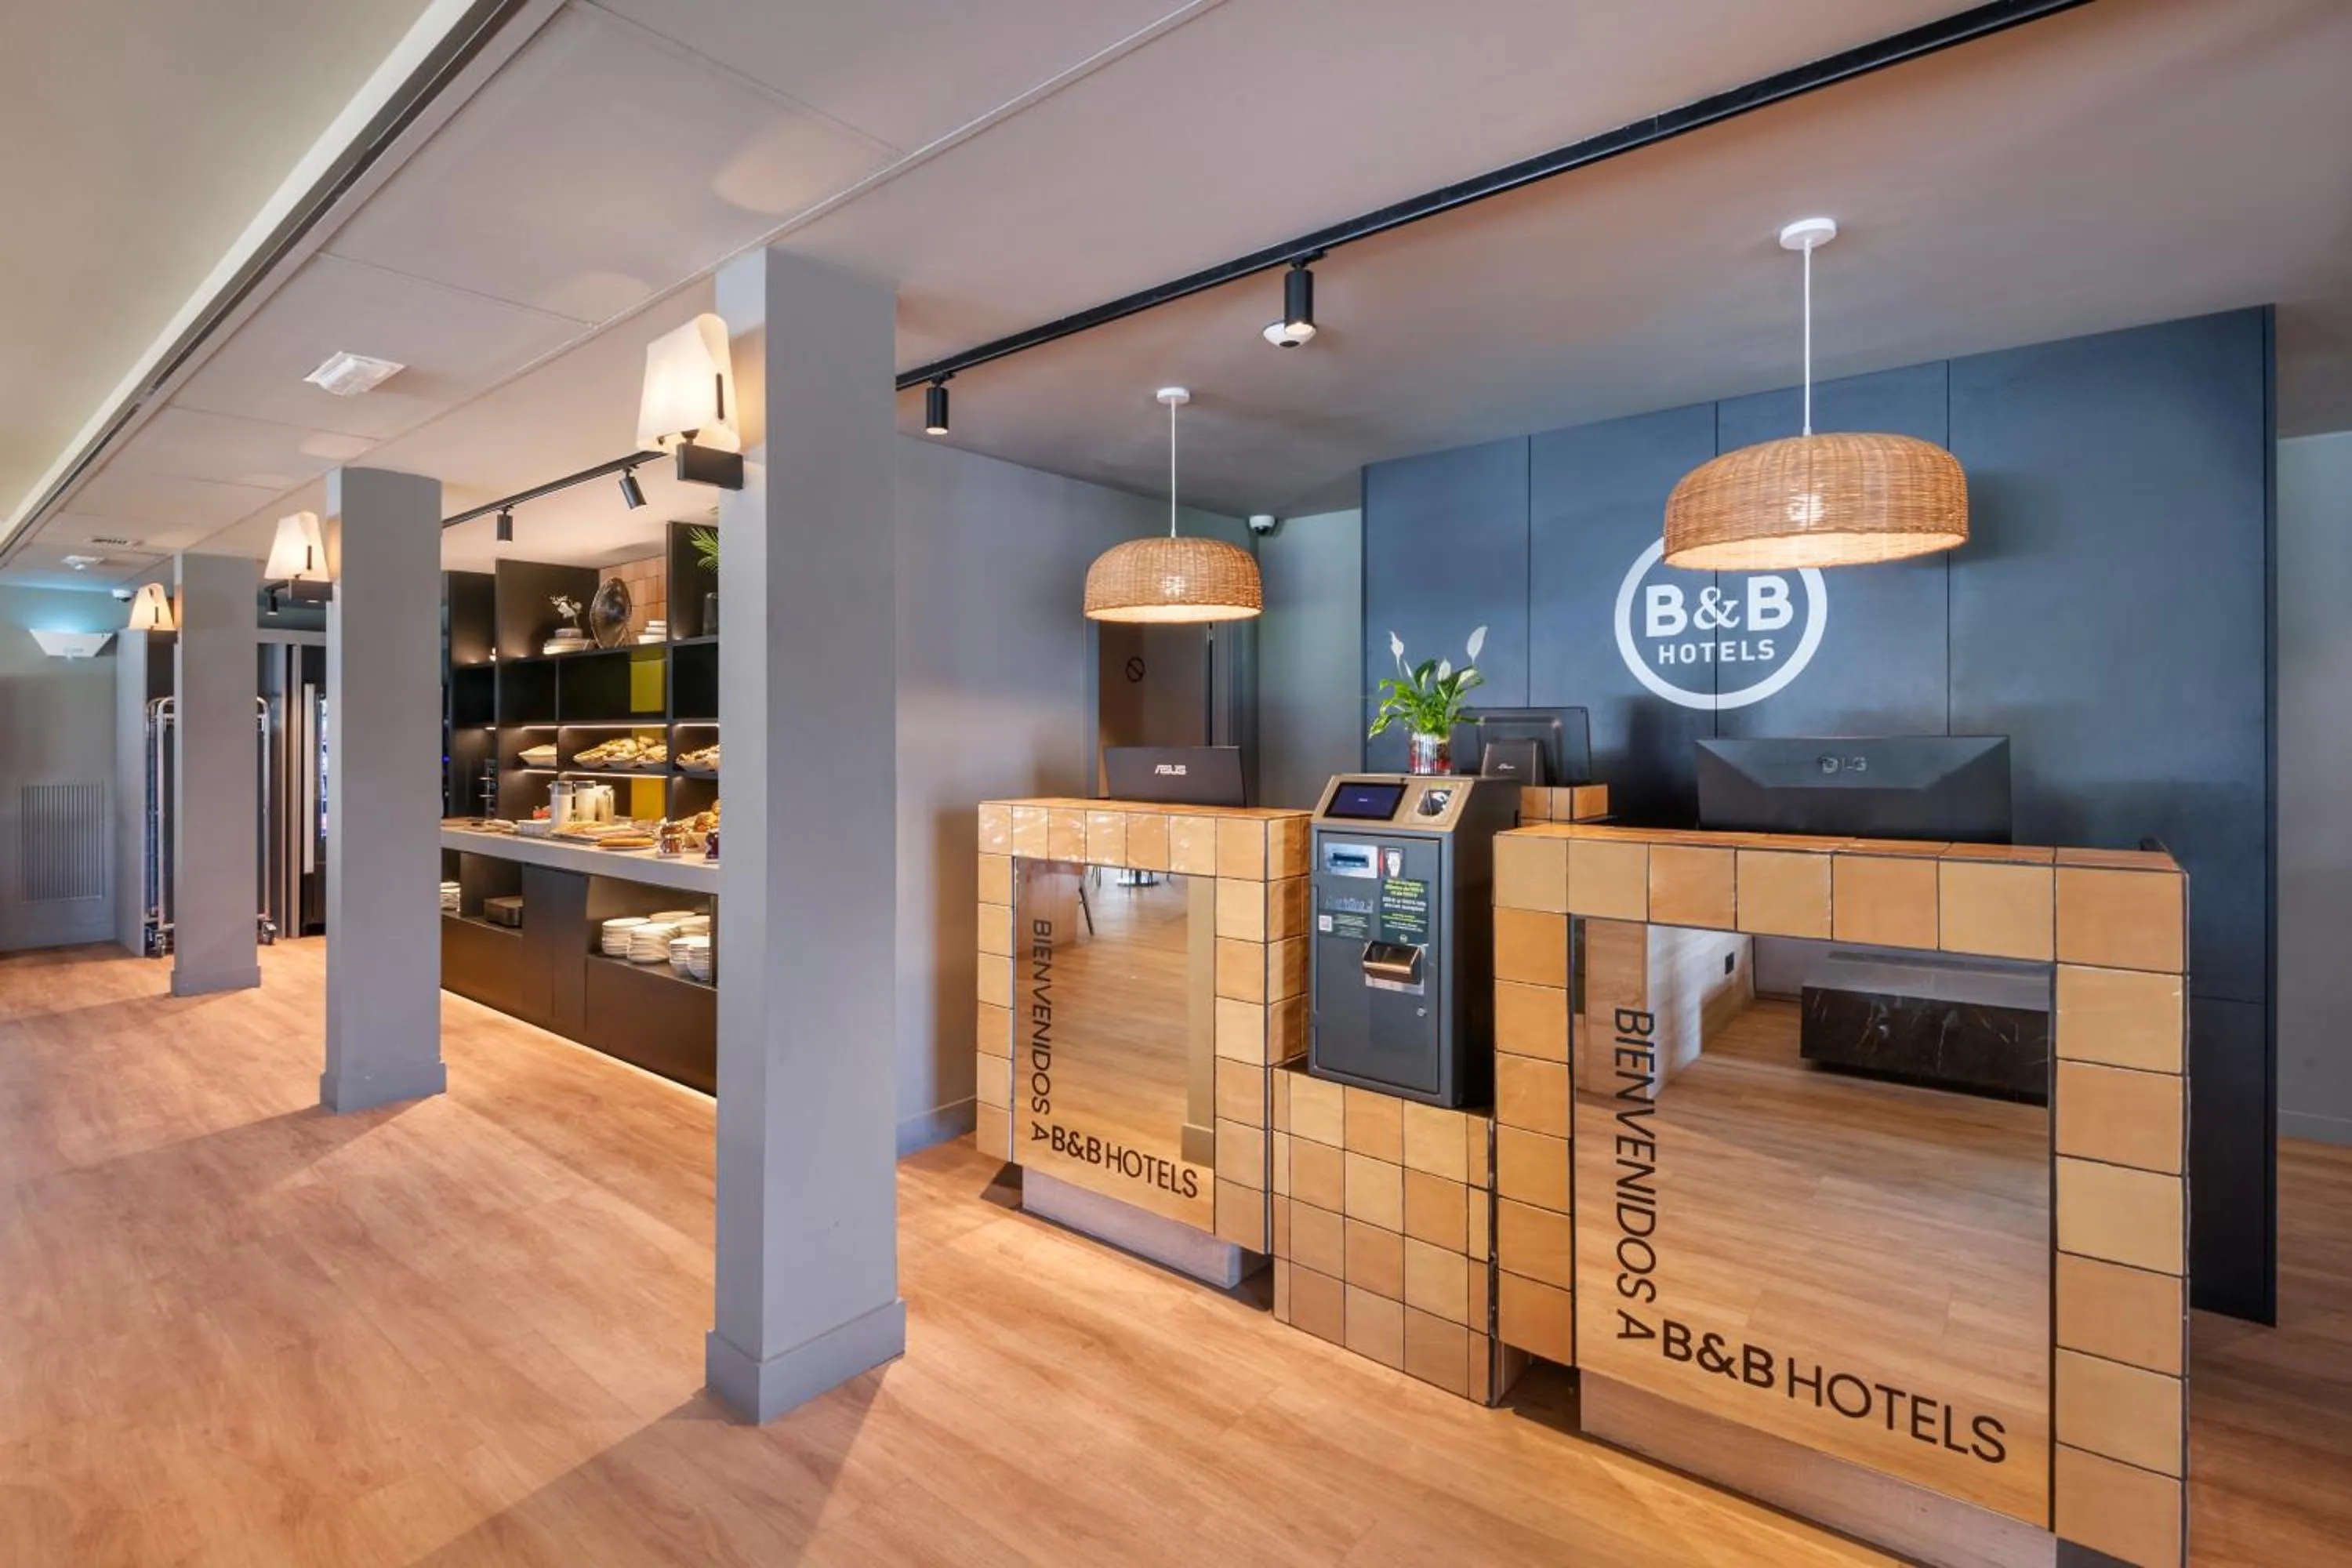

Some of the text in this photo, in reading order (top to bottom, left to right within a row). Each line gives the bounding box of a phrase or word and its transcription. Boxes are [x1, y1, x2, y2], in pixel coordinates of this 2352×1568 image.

[1646, 575, 1794, 637] B&B
[1658, 639, 1776, 665] HOTELS
[1154, 764, 1186, 775] ASUS
[1031, 919, 1052, 1141] BIENVENIDOS A
[1051, 1124, 1198, 1199] B&B HOTELS
[1614, 1007, 1657, 1340] BIENVENIDOS A
[1662, 1319, 2007, 1464] B&B HOTELS
